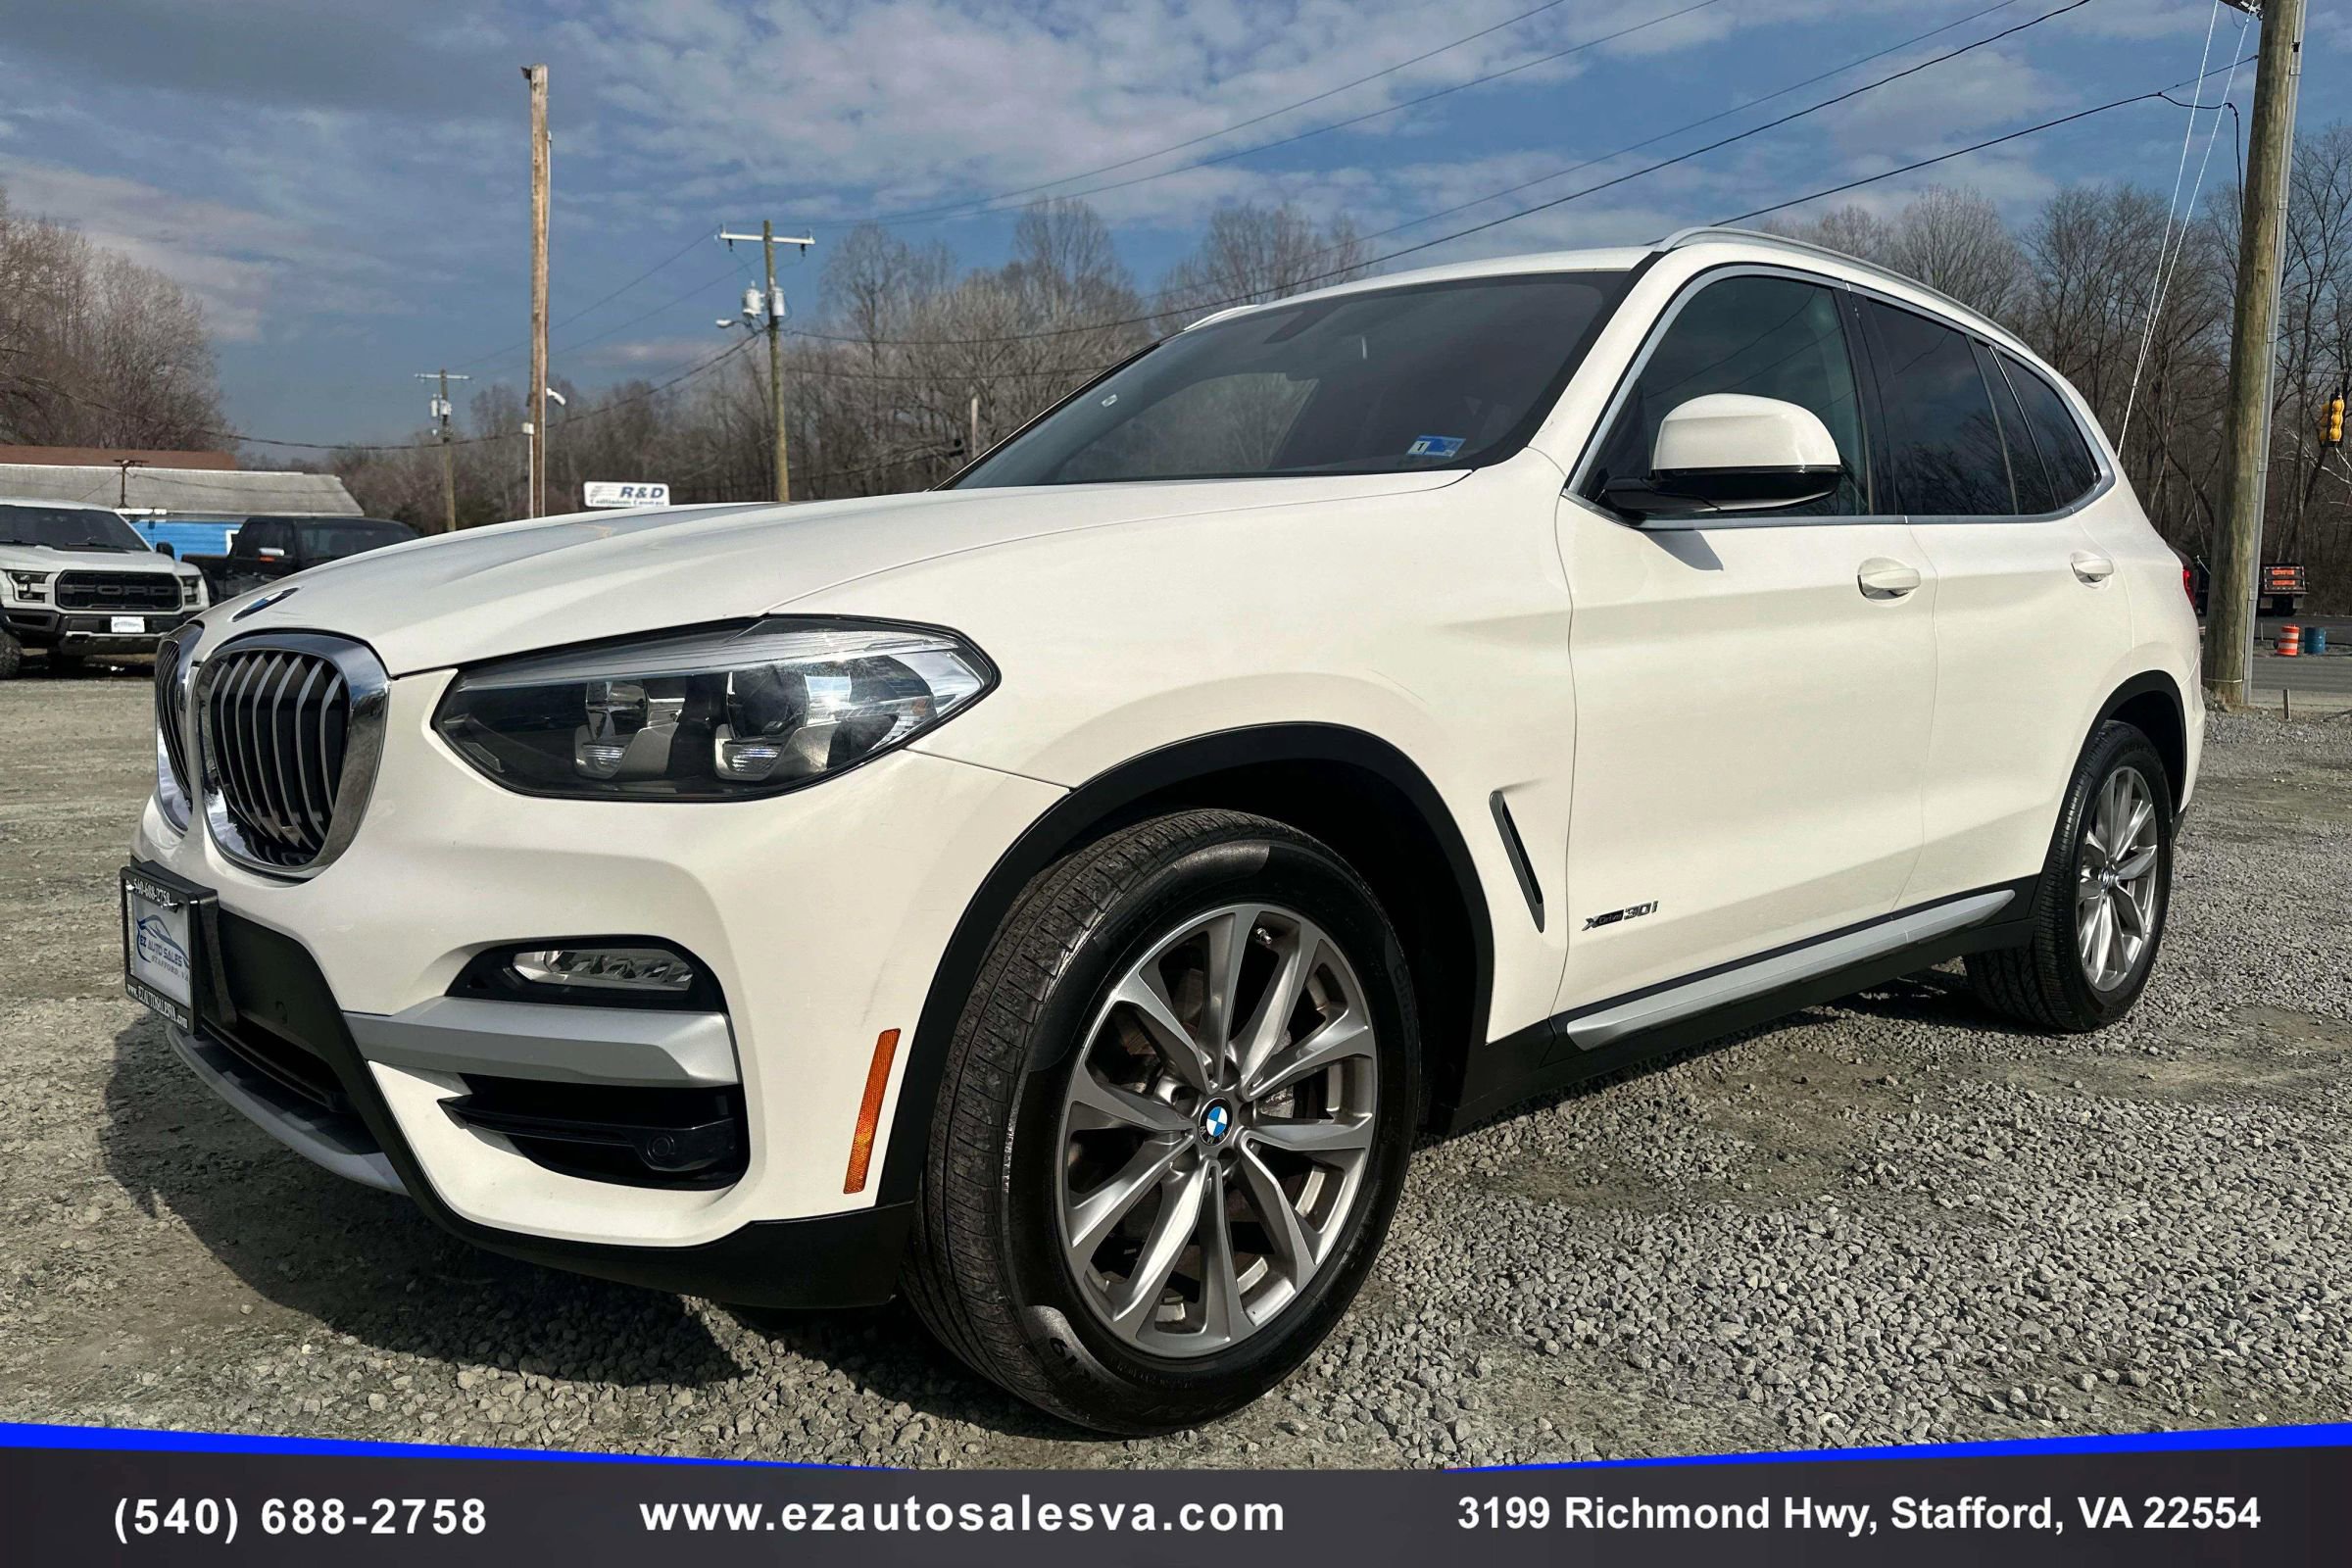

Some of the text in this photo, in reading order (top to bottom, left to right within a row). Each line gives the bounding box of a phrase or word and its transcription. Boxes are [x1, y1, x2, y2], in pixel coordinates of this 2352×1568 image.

[619, 486, 664, 500] R&D
[60, 584, 173, 597] FORD
[139, 934, 183, 967] EZ AUTO SALES
